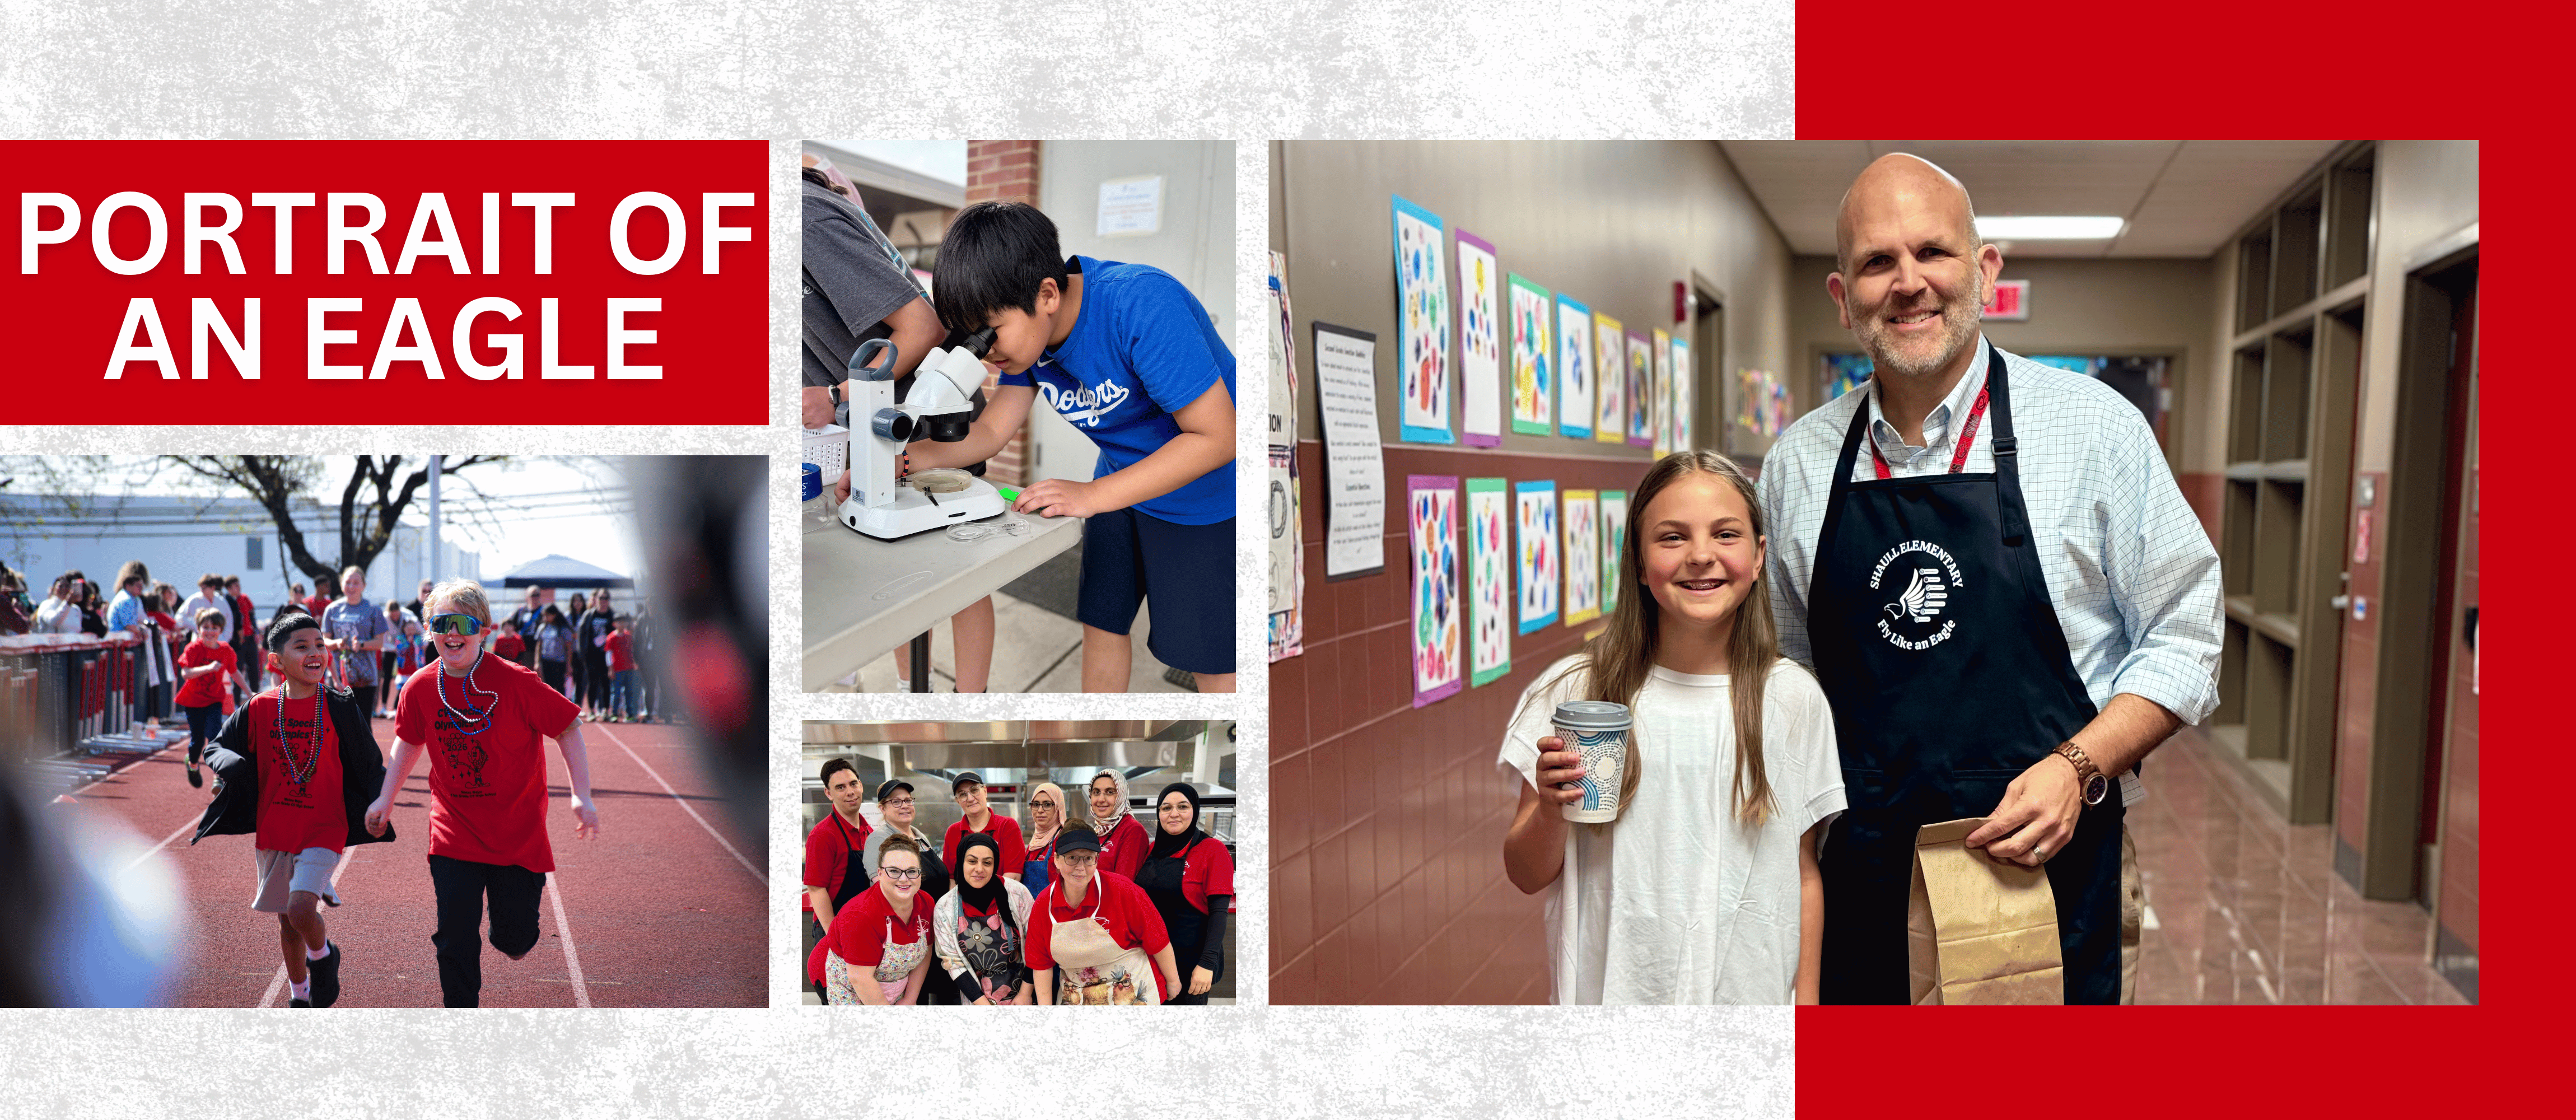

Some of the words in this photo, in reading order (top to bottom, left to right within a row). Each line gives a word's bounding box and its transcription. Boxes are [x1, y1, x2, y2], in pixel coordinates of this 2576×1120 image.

[1037, 379, 1128, 427] Dodgers
[1268, 413, 1282, 433] ION
[1870, 548, 1900, 590] SHAULL
[1900, 540, 1963, 587] ELEMENTARY
[1877, 618, 1892, 638] Fly
[1889, 632, 1913, 650] Like
[1915, 640, 1929, 650] an
[1929, 619, 1956, 646] Eagle
